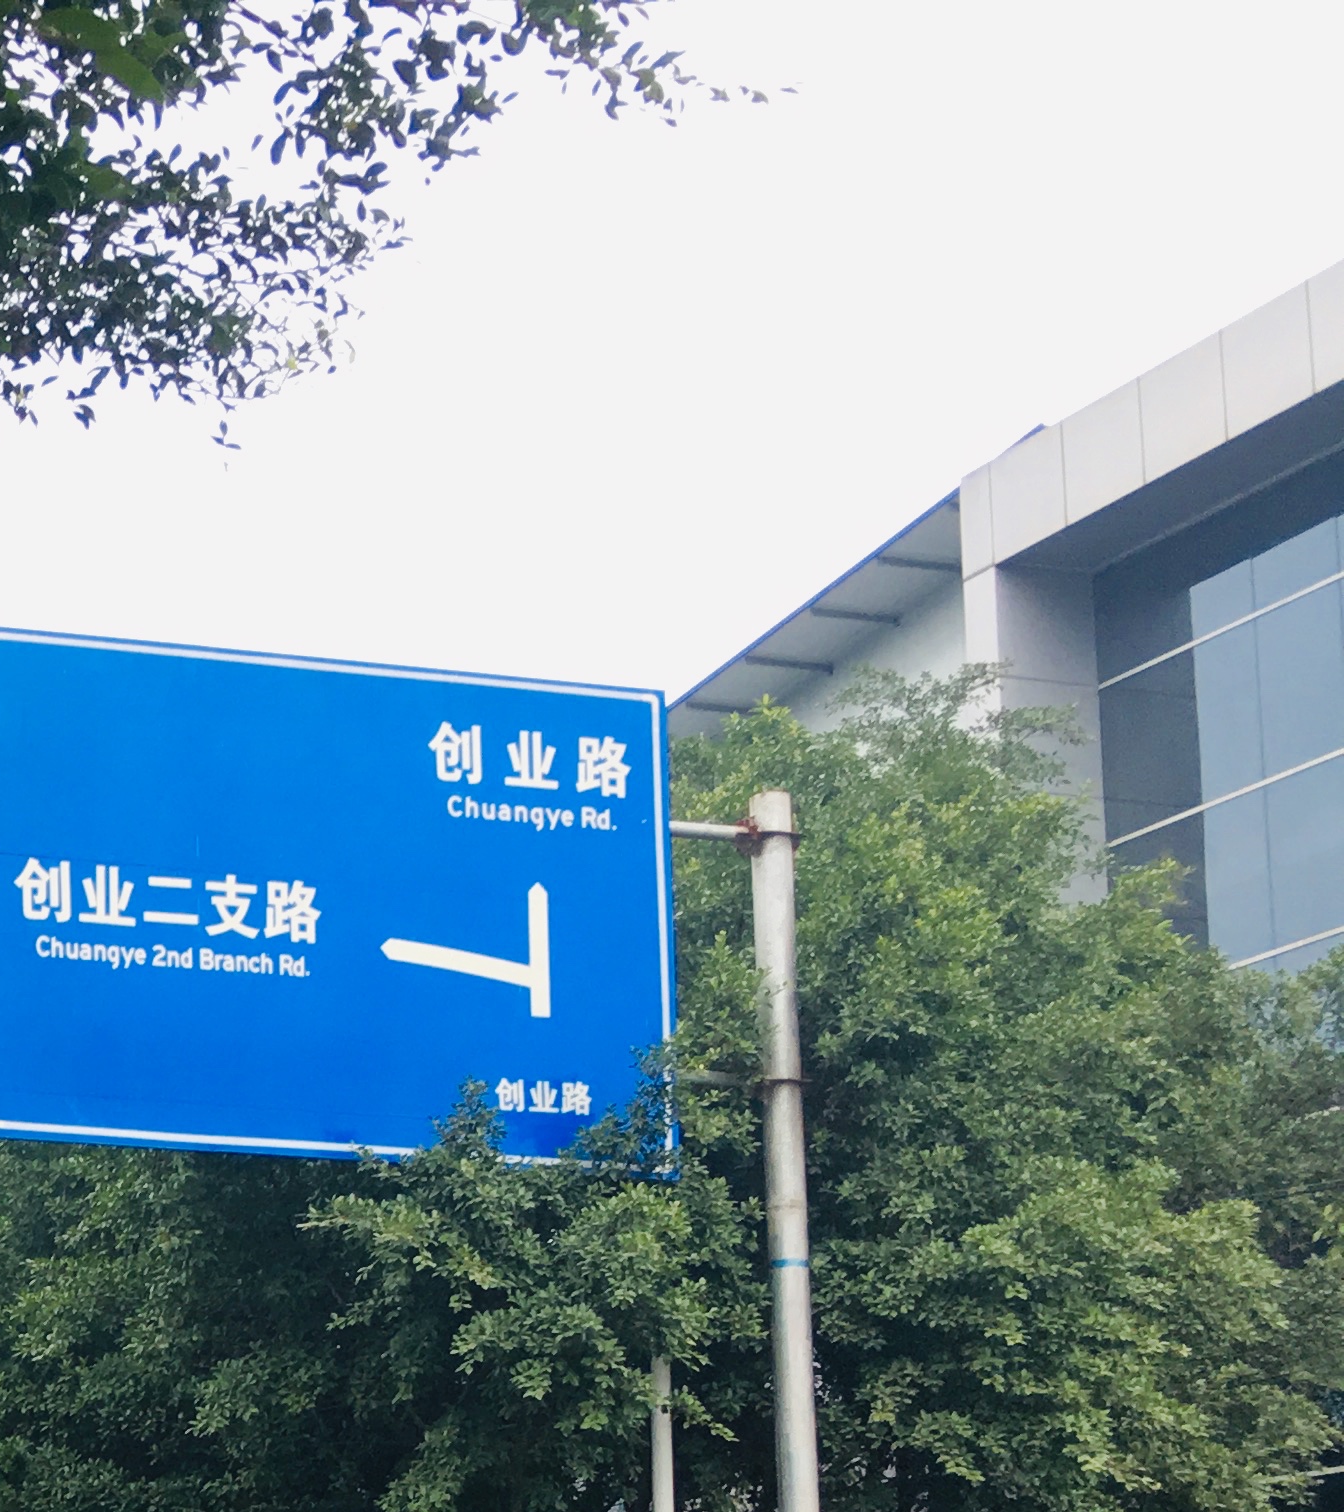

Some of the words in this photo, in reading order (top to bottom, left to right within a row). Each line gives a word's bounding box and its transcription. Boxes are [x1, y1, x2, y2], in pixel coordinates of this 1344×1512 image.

[427, 721, 631, 799] 创业路
[447, 795, 574, 832] Chuangye
[581, 806, 618, 831] Rd.
[13, 857, 322, 944] 创业二支路
[35, 935, 146, 970] Chuangye
[152, 944, 193, 969] 2nd
[199, 947, 274, 975] Branch
[279, 953, 311, 977] Rd.
[494, 1077, 592, 1116] 创业路
